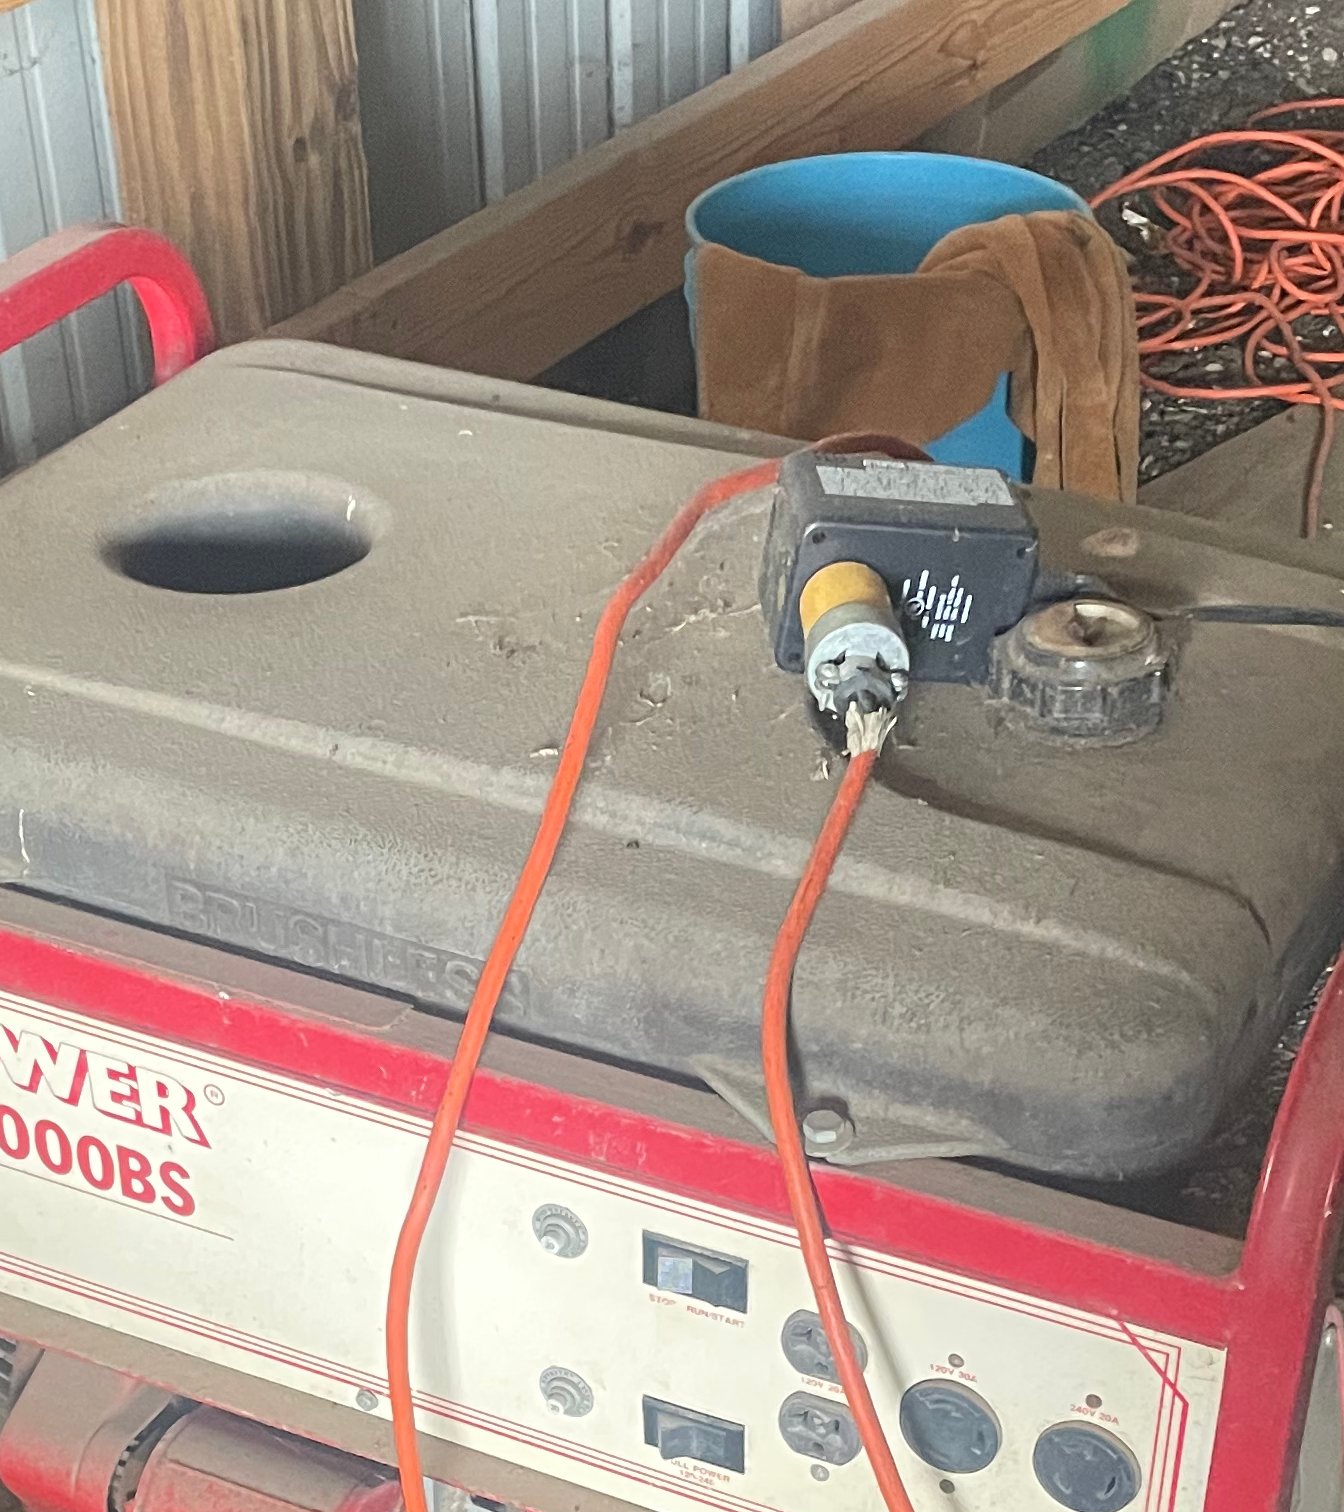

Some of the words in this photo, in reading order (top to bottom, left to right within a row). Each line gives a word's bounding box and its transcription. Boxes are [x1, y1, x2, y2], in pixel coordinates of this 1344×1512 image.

[929, 1363, 955, 1376] 120V
[1069, 1403, 1097, 1417] 240V
[1099, 1412, 1120, 1426] 20A
